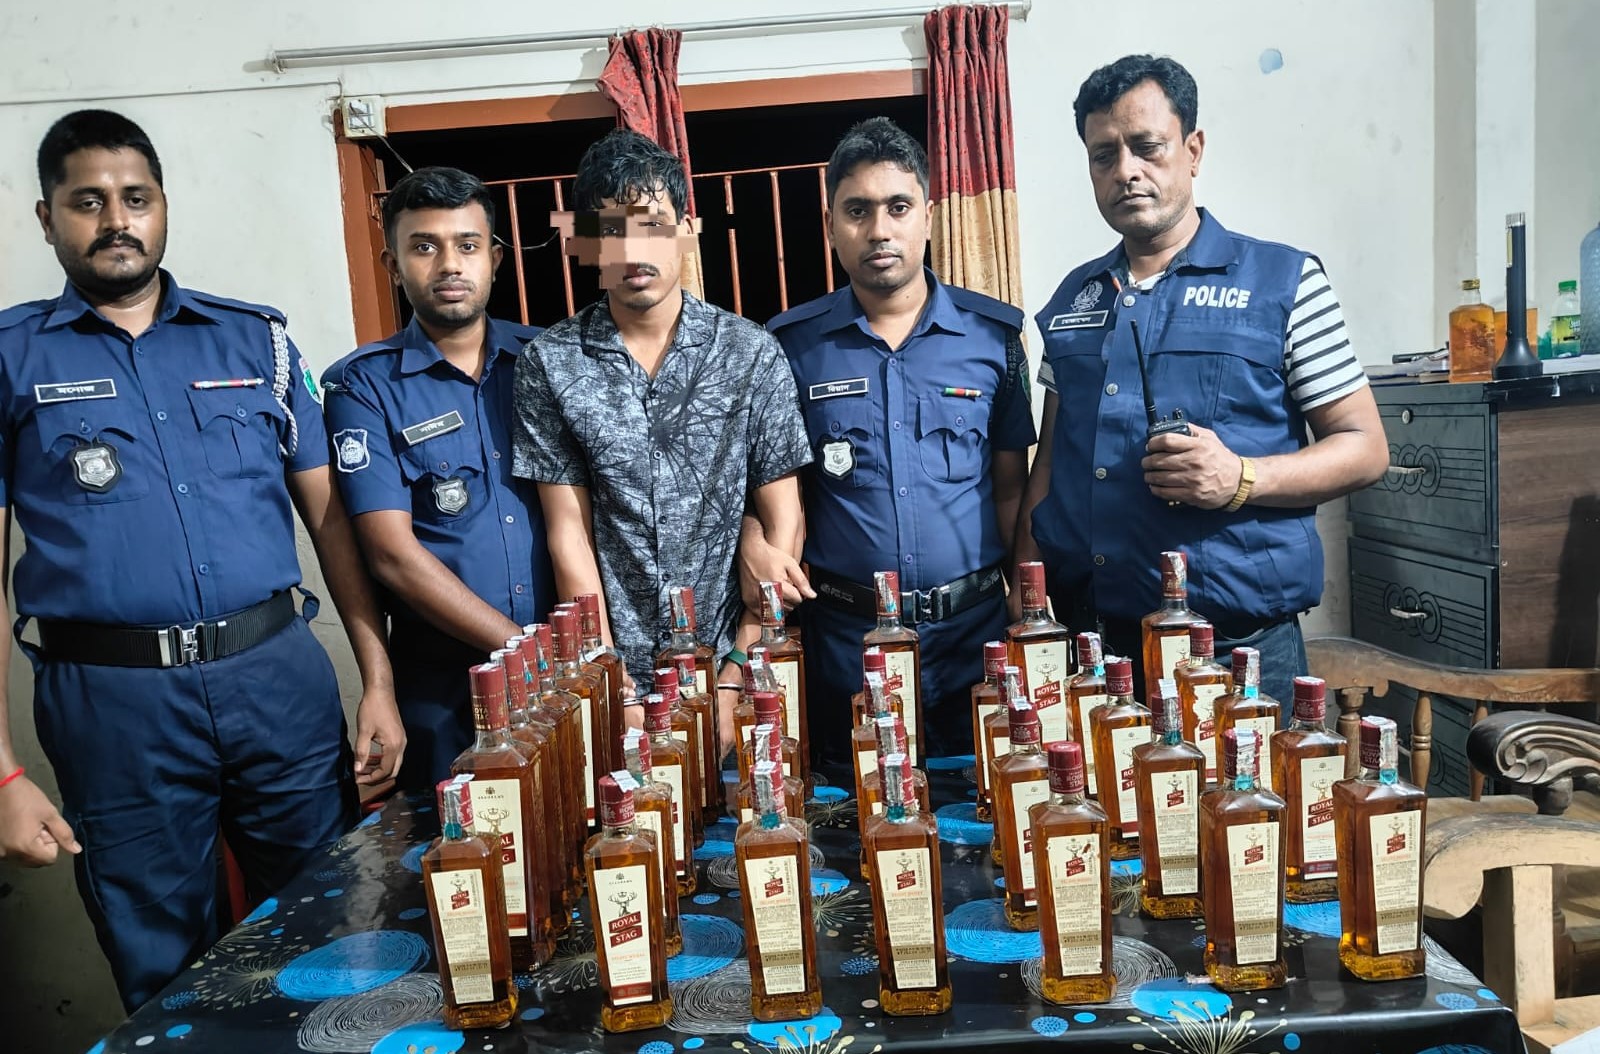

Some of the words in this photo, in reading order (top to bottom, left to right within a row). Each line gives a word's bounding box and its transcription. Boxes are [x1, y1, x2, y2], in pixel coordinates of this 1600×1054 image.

[1183, 285, 1251, 309] POLICE
[1037, 684, 1059, 696] ROYAL
[1039, 696, 1057, 708] STAG
[1311, 800, 1333, 813] ROYAL
[1312, 813, 1332, 825] STAG
[612, 915, 638, 931] ROYAL
[615, 930, 638, 943] STAG
